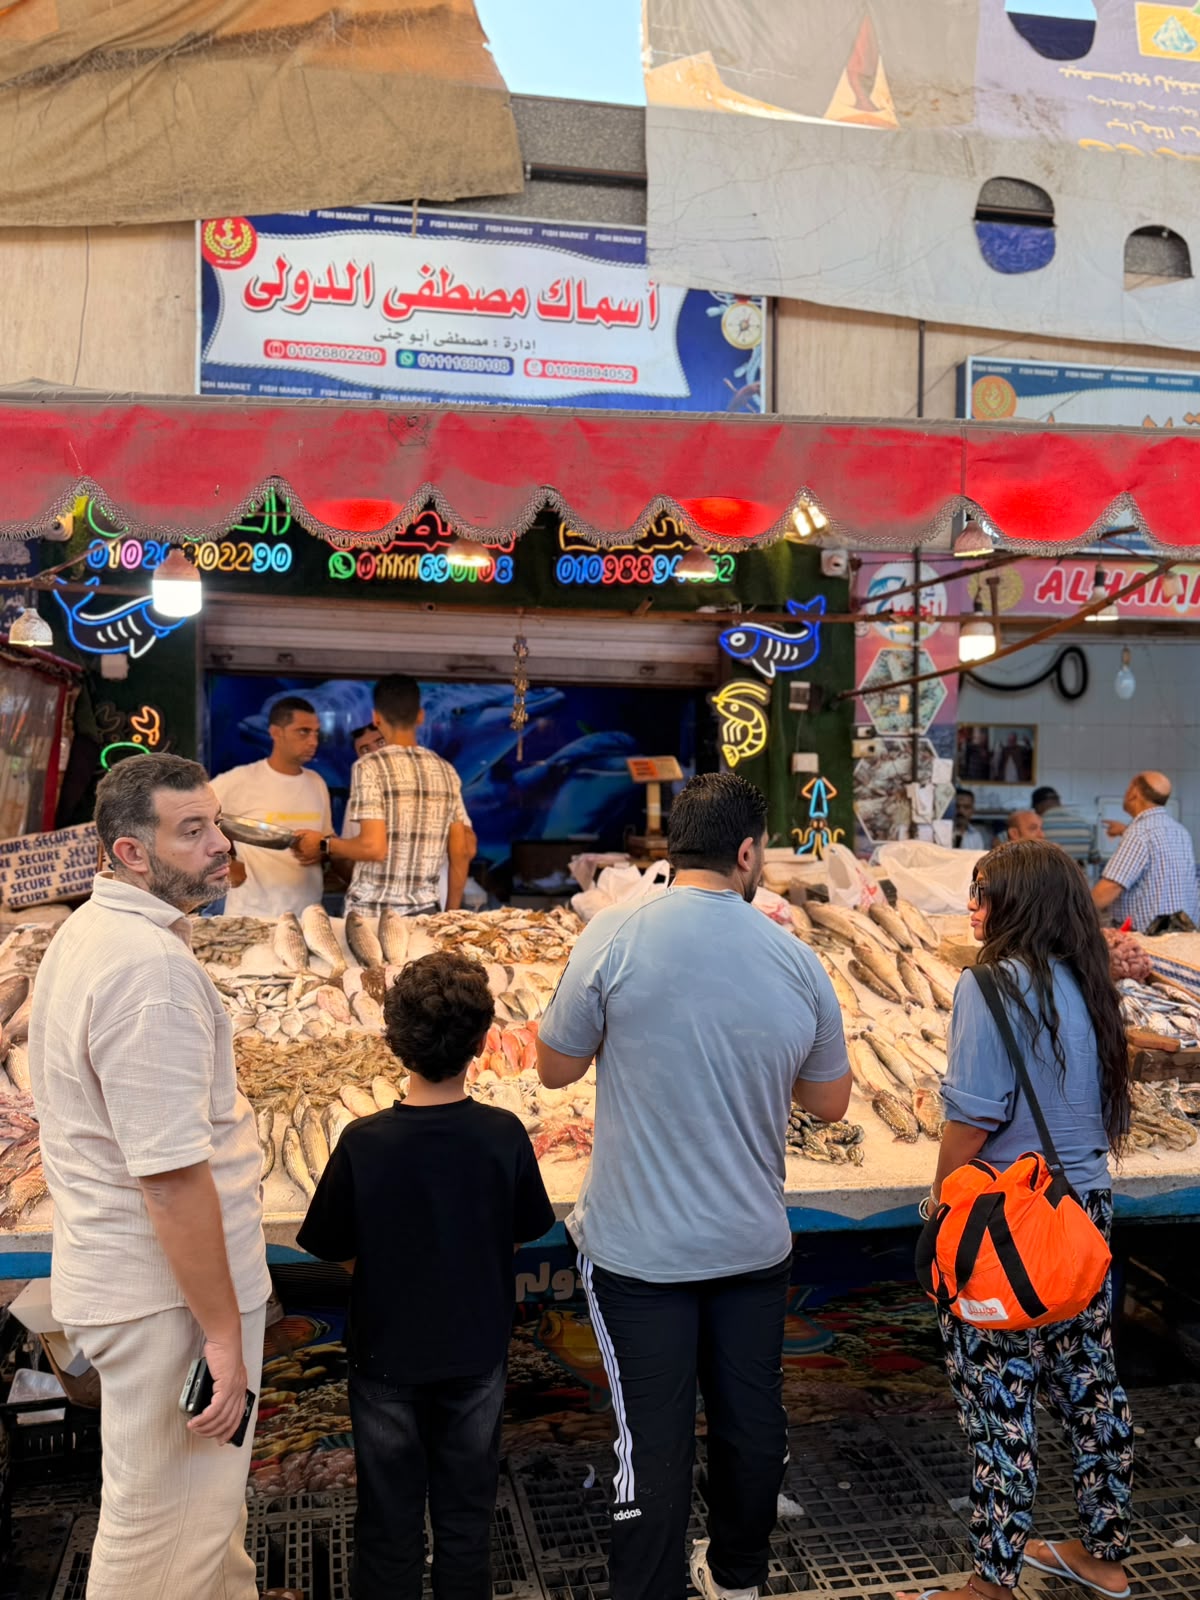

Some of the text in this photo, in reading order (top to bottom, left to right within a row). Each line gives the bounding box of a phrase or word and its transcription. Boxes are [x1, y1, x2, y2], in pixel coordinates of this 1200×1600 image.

[243, 252, 374, 313] الدولى
[382, 262, 530, 321] مصطفى
[433, 332, 489, 347] مصطفى
[503, 336, 536, 354] إدارة
[288, 344, 381, 362] 01026802290
[420, 353, 510, 373] 01111690108
[546, 364, 633, 380] 01098894052
[0, 838, 29, 855] CURE
[35, 829, 79, 848] SECURE
[18, 849, 61, 866] SECURE
[67, 844, 97, 858] SECU
[10, 876, 53, 894] SECURE
[59, 867, 95, 884] SECUR
[14, 863, 57, 880] SECURE
[7, 881, 94, 907] SECURE SECUR
